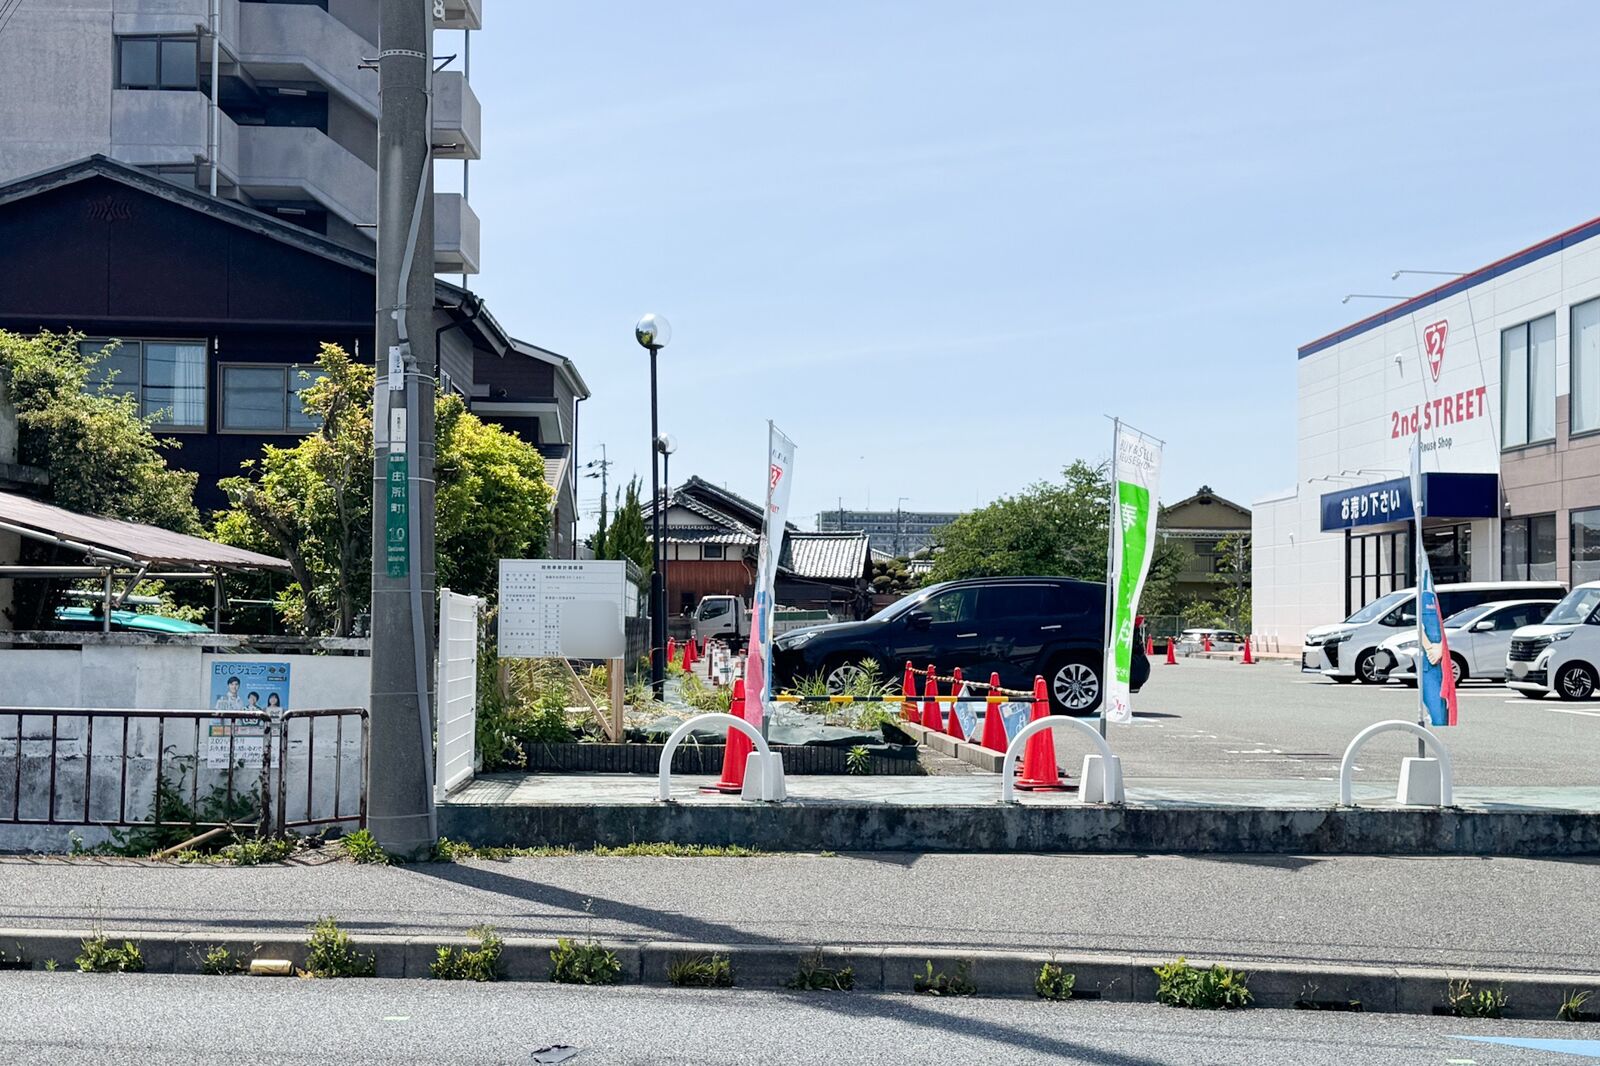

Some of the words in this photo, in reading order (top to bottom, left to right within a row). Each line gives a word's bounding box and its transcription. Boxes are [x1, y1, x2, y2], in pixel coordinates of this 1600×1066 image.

[1391, 405, 1419, 439] 2nd
[1423, 386, 1486, 431] STREET
[1419, 441, 1437, 453] Reuse
[1438, 436, 1453, 450] Shop
[1341, 489, 1400, 520] お売り下さい
[214, 664, 267, 675] ECCジュニア
